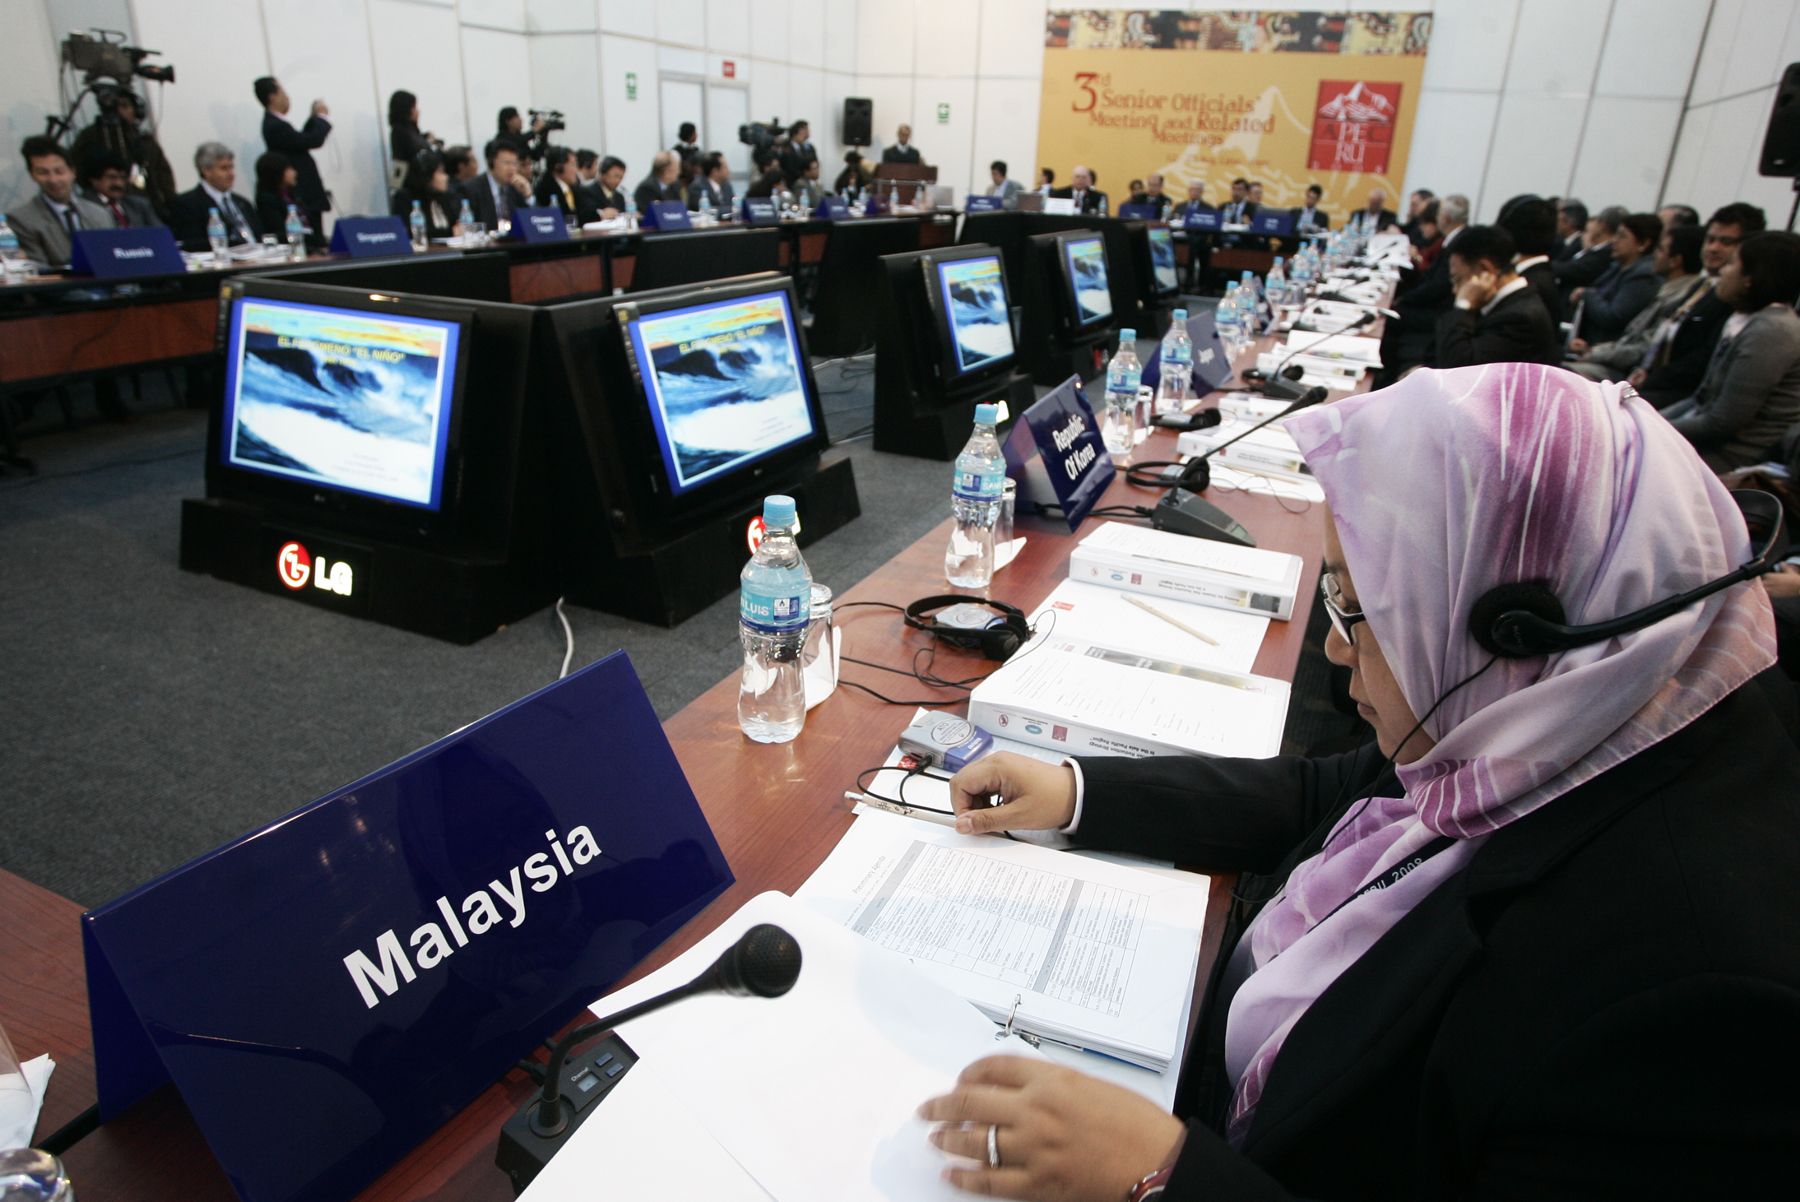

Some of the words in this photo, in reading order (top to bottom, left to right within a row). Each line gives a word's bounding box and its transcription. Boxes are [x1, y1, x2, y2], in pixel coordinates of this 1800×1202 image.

[1101, 88, 1168, 109] Senior
[1089, 111, 1158, 131] Meeting
[1163, 117, 1191, 129] and
[1197, 111, 1275, 133] Related
[113, 247, 155, 259] Russia
[1052, 415, 1085, 452] Republic
[1074, 443, 1096, 473] Korea
[315, 556, 353, 596] LG
[343, 825, 602, 1009] Malaysia
